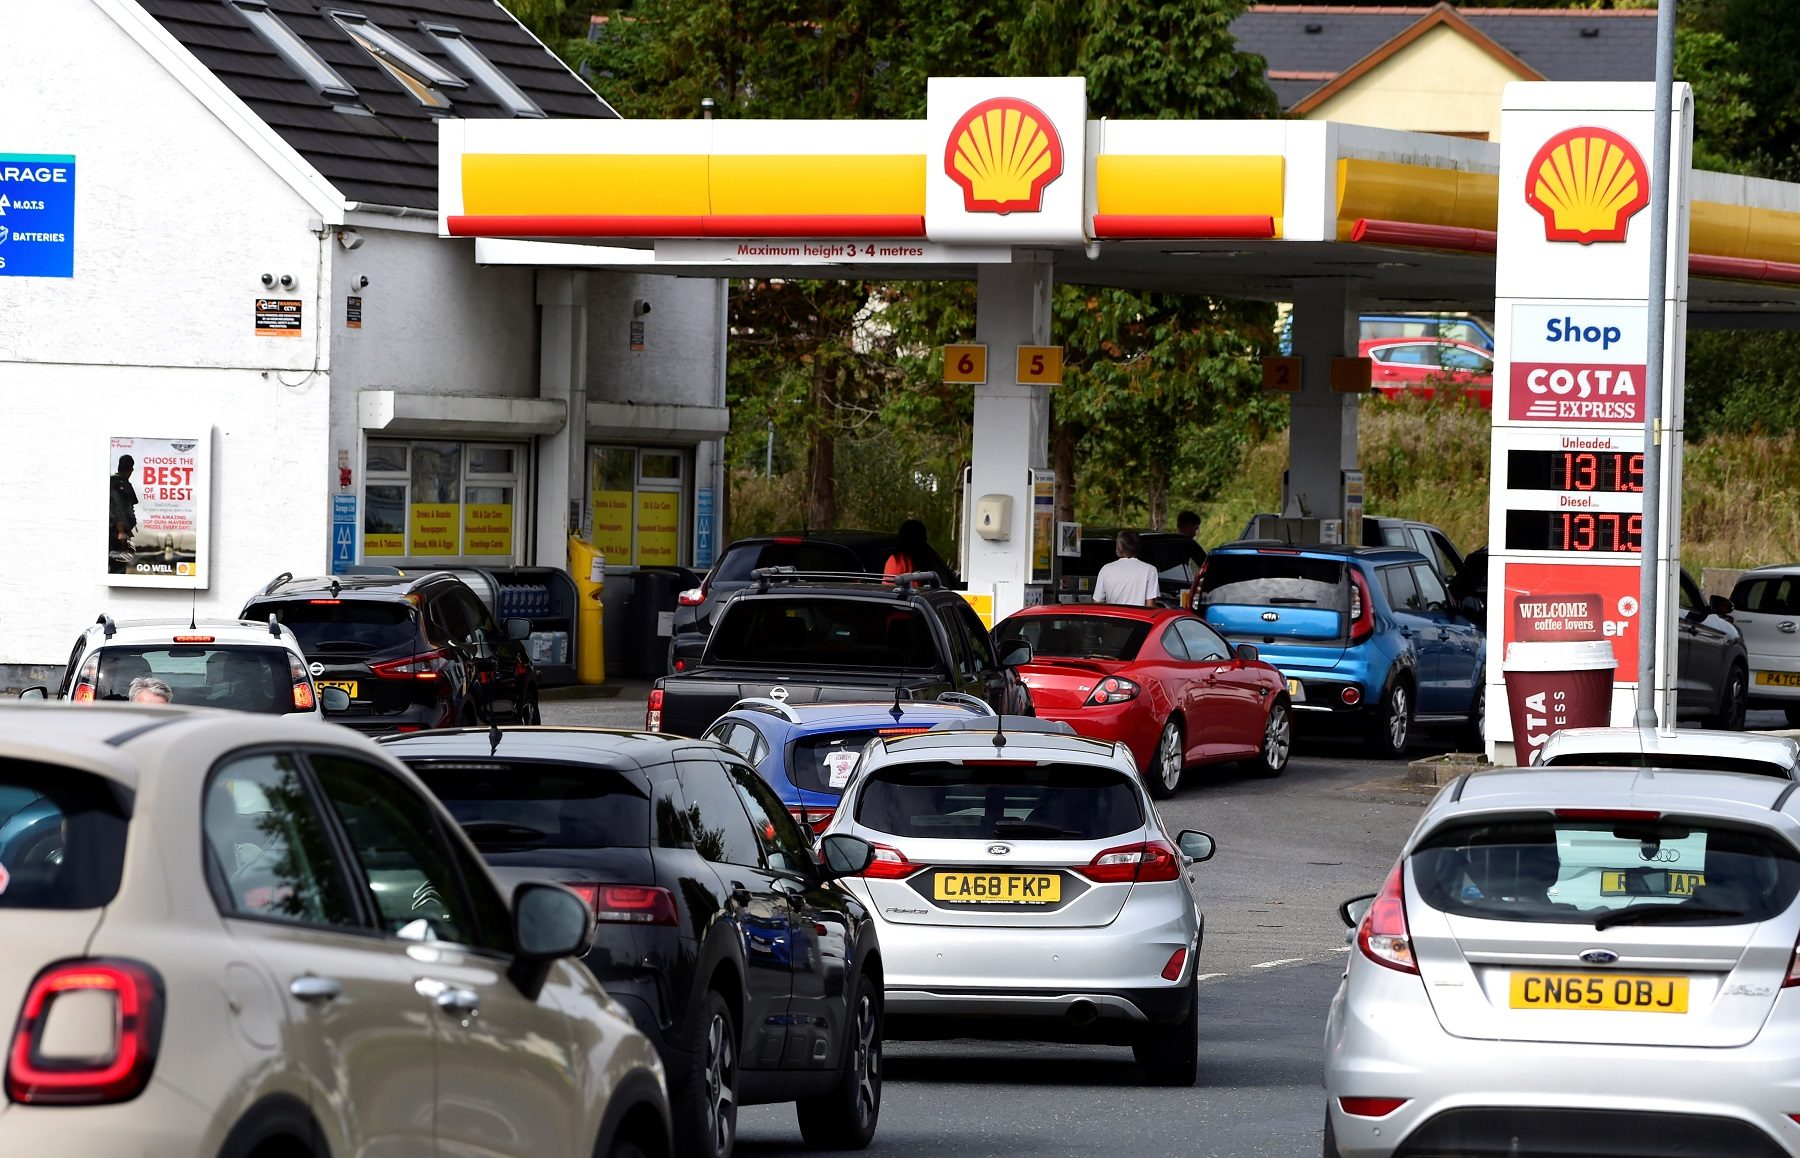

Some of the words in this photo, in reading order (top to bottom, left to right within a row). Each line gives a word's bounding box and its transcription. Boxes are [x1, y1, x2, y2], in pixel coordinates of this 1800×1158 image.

[13, 200, 45, 210] M.O.T.S
[12, 232, 65, 243] BATTERIES
[737, 244, 800, 256] Maximum
[803, 244, 844, 259] height
[879, 245, 923, 256] metres
[1546, 316, 1621, 351] Shop
[957, 353, 974, 375] 6
[1029, 354, 1045, 376] 5
[1276, 364, 1289, 384] 2
[1526, 368, 1636, 399] COSTA
[1558, 400, 1636, 419] EXPRESS
[1562, 437, 1611, 450] Unleaded
[143, 457, 177, 465] CHOOSE
[143, 466, 194, 486] BEST
[160, 488, 193, 501] BEST
[1560, 495, 1591, 508] Diesel
[136, 563, 151, 572] GO
[151, 564, 173, 573] WELL
[1519, 602, 1588, 619] WELCOME
[1534, 619, 1562, 631] coffee
[1602, 620, 1629, 637] er
[1767, 673, 1780, 685] P4
[944, 875, 1002, 897] CA68
[1008, 876, 1051, 897] FKP
[1524, 977, 1604, 1005] CN65
[1614, 979, 1674, 1007] OBJ
